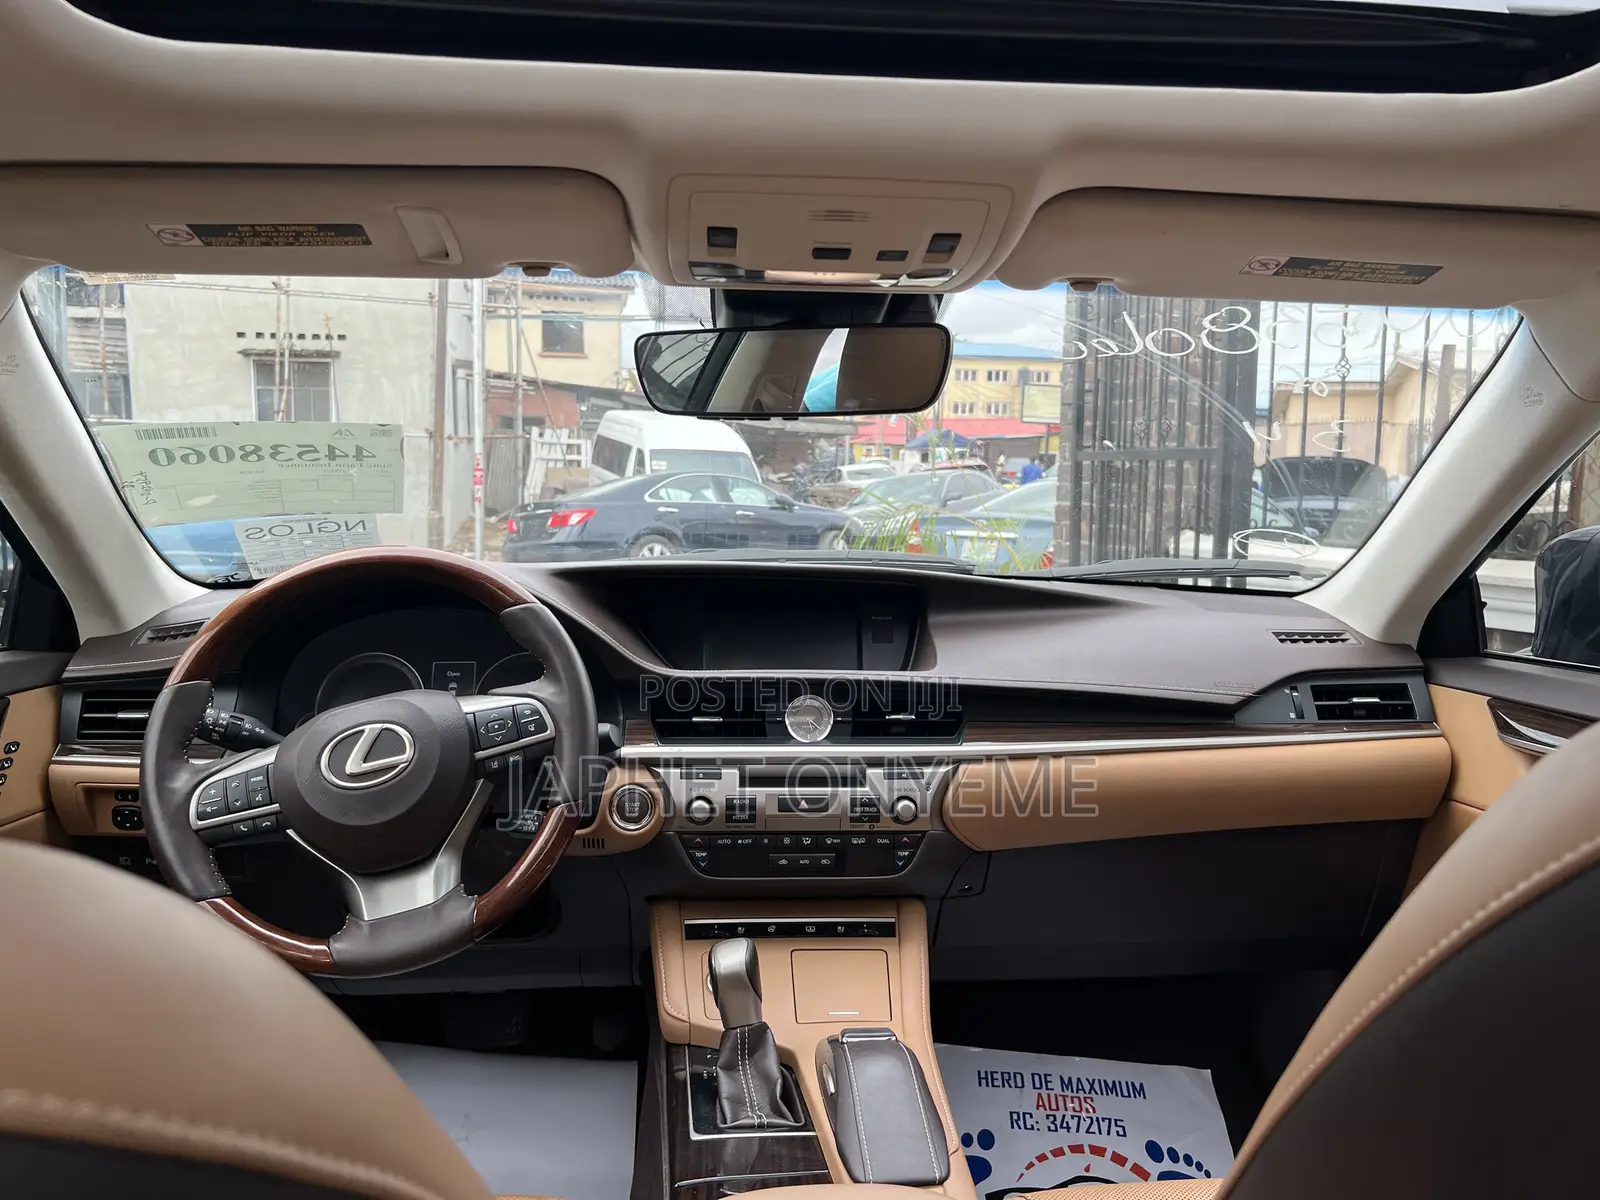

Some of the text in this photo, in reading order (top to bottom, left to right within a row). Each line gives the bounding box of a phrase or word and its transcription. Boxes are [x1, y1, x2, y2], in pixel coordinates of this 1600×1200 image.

[250, 775, 264, 783] MODE
[1030, 1072, 1055, 1091] DE
[1058, 1074, 1147, 1100] MAXIMUM
[1035, 1091, 1097, 1114] AUTOS
[1008, 1110, 1128, 1138] RC: 3472175
